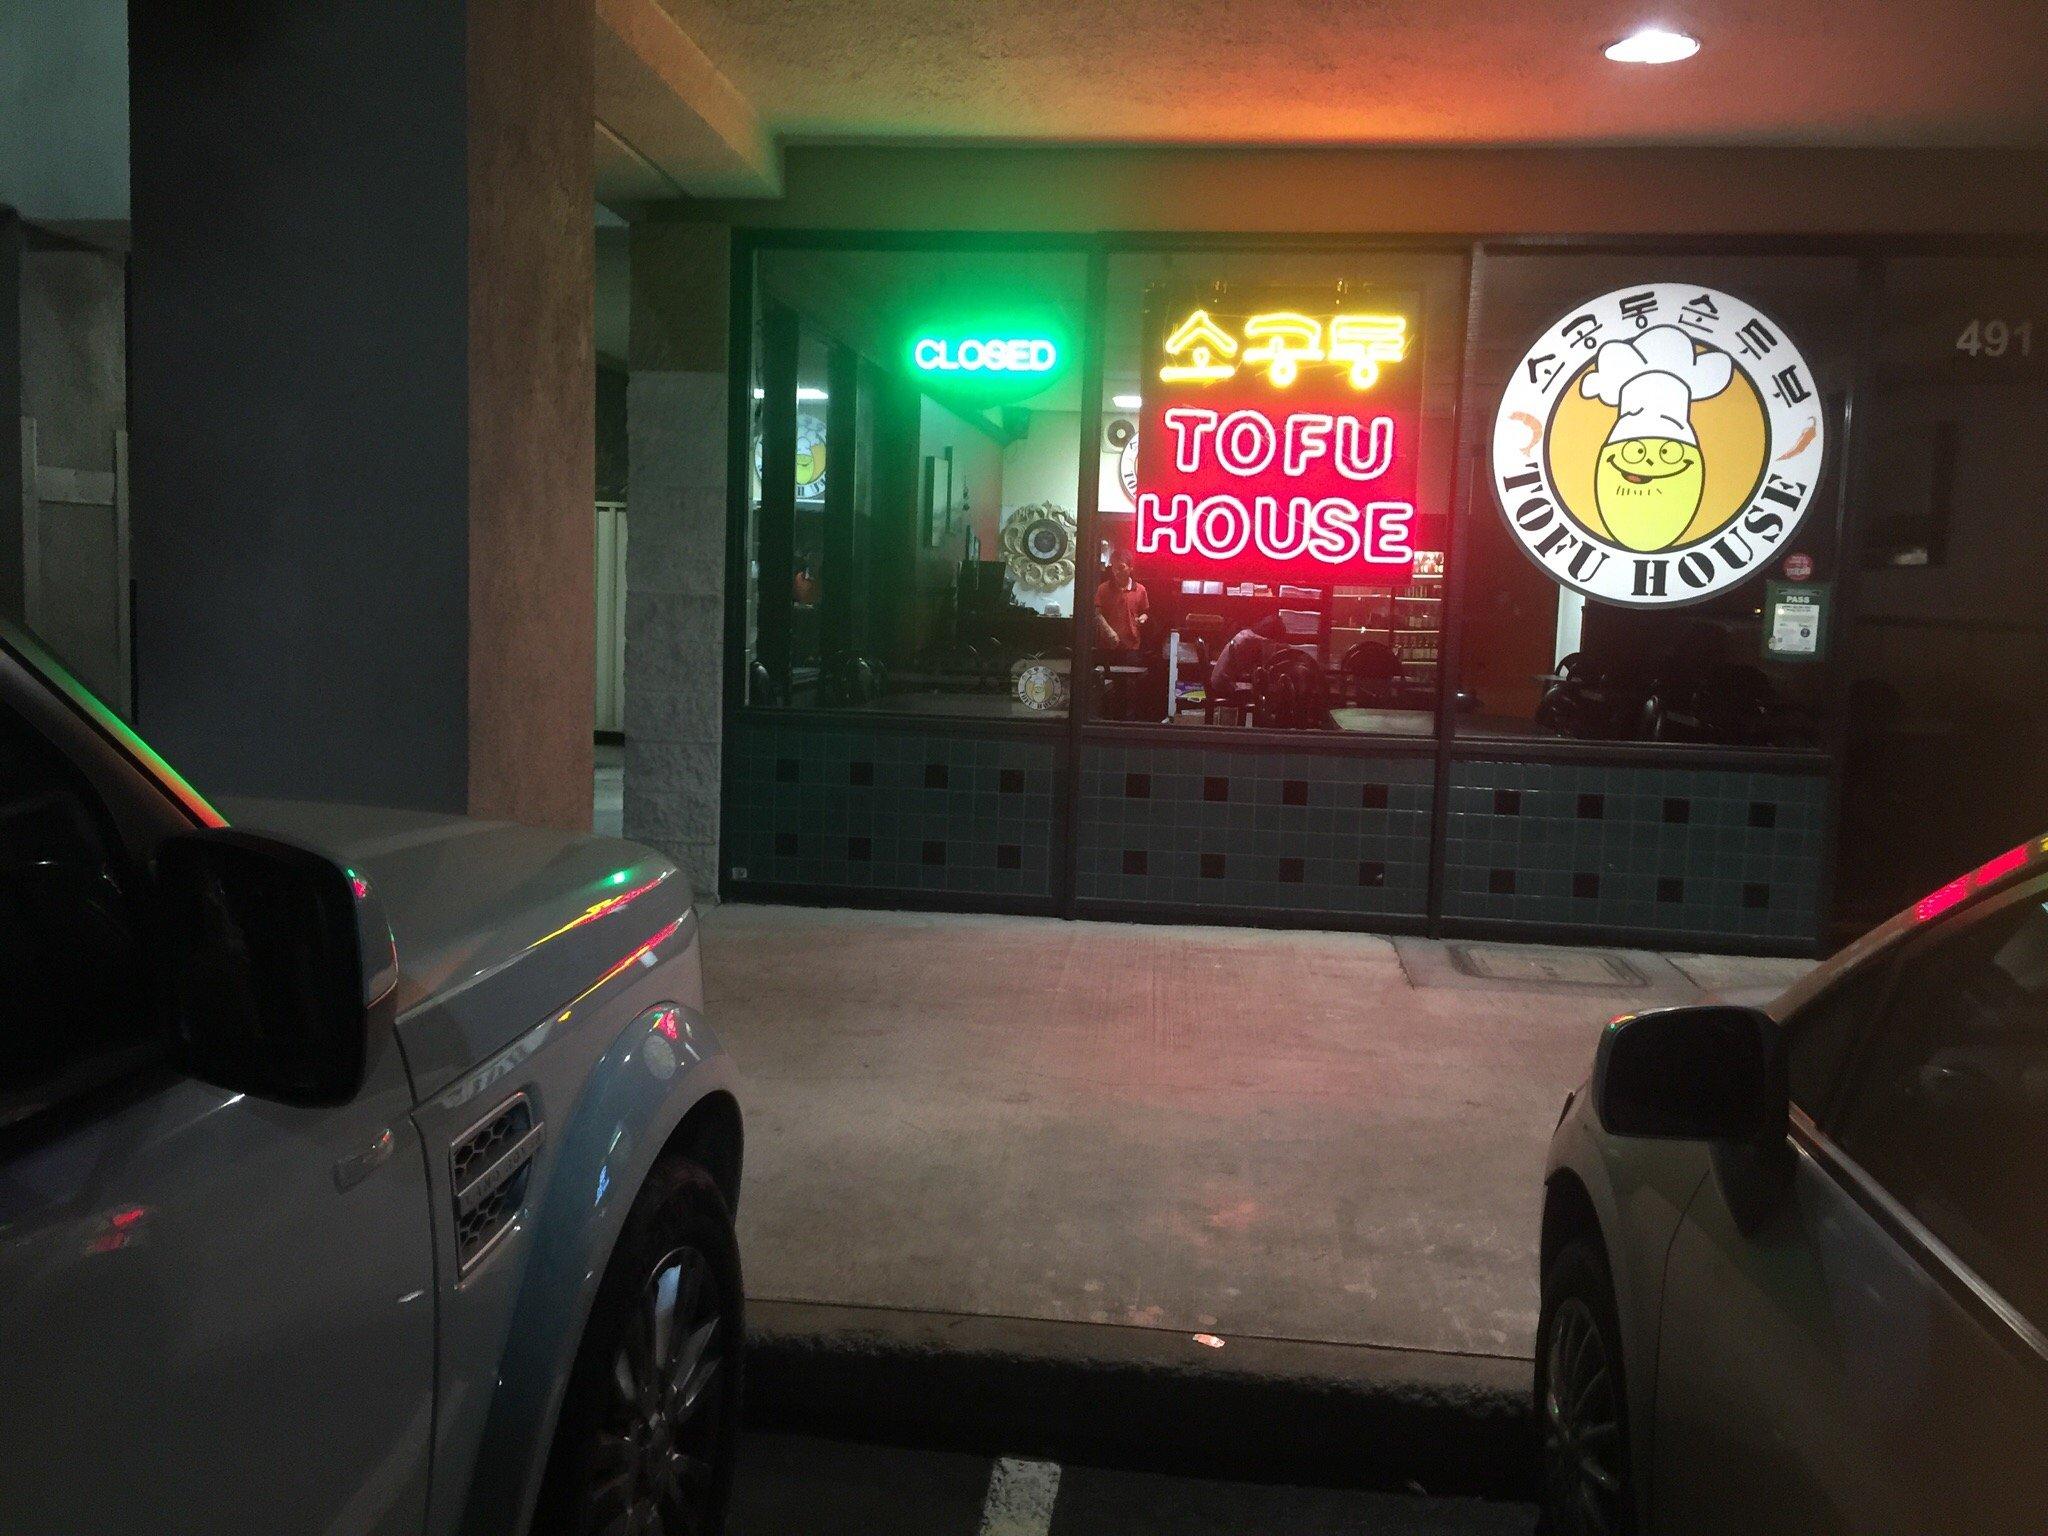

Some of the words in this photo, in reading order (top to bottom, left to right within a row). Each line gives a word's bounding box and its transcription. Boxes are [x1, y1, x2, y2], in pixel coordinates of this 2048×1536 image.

[914, 338, 1057, 371] CLOSED
[1159, 309, 1407, 389] 소공동
[1956, 319, 2033, 357] 491
[1164, 408, 1394, 481] TOFU
[1136, 493, 1414, 564] HOUSE
[1503, 462, 1610, 582] TOFU
[1631, 473, 1807, 597] HOUSE
[1786, 595, 1810, 604] PASS
